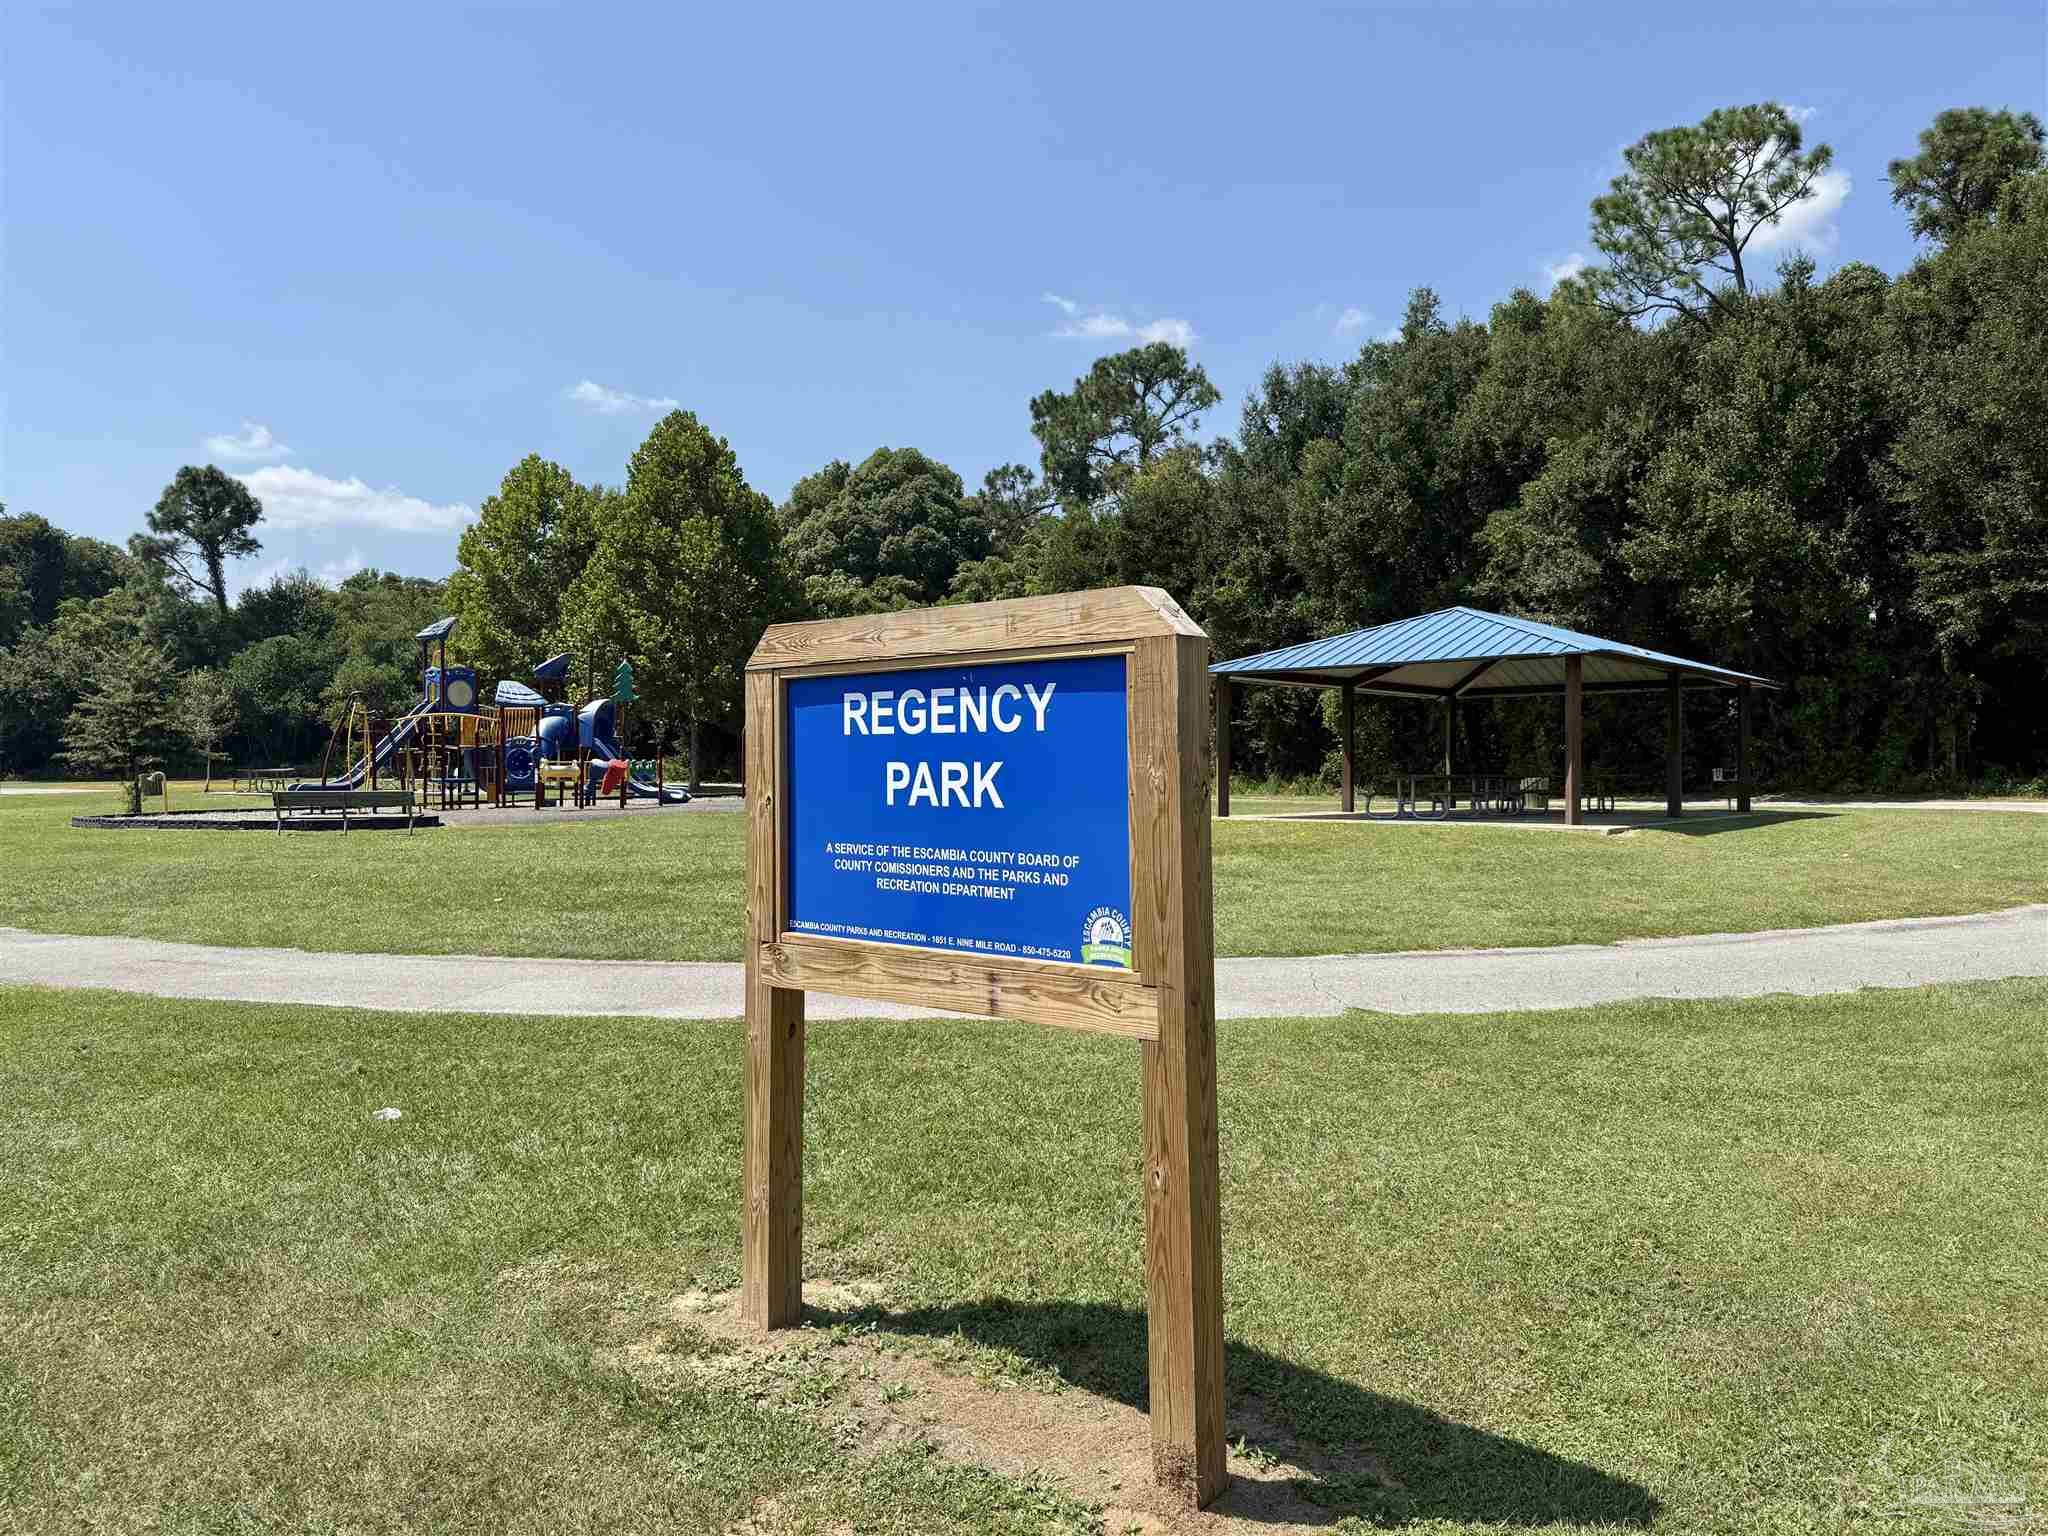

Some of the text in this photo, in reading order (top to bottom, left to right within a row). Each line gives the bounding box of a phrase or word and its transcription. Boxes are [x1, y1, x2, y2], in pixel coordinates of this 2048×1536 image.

[843, 683, 1056, 735] REGENCY
[886, 761, 1004, 808] PARK
[826, 843, 1079, 868] A SERVICE OF THE ESCAMBIA COUNTY BOARD OF
[834, 859, 1069, 886] COUNTY COMISSIONERS AND THE PARKS AND
[876, 878, 1015, 900] RECREATION DEPARTMENT
[820, 923, 846, 932] COUNTY
[847, 926, 868, 936] PARKS
[869, 929, 883, 937] AND
[884, 930, 927, 942] RECREATION
[957, 938, 974, 947] NINE
[976, 940, 992, 950] MILE
[994, 943, 1016, 952] ROAD
